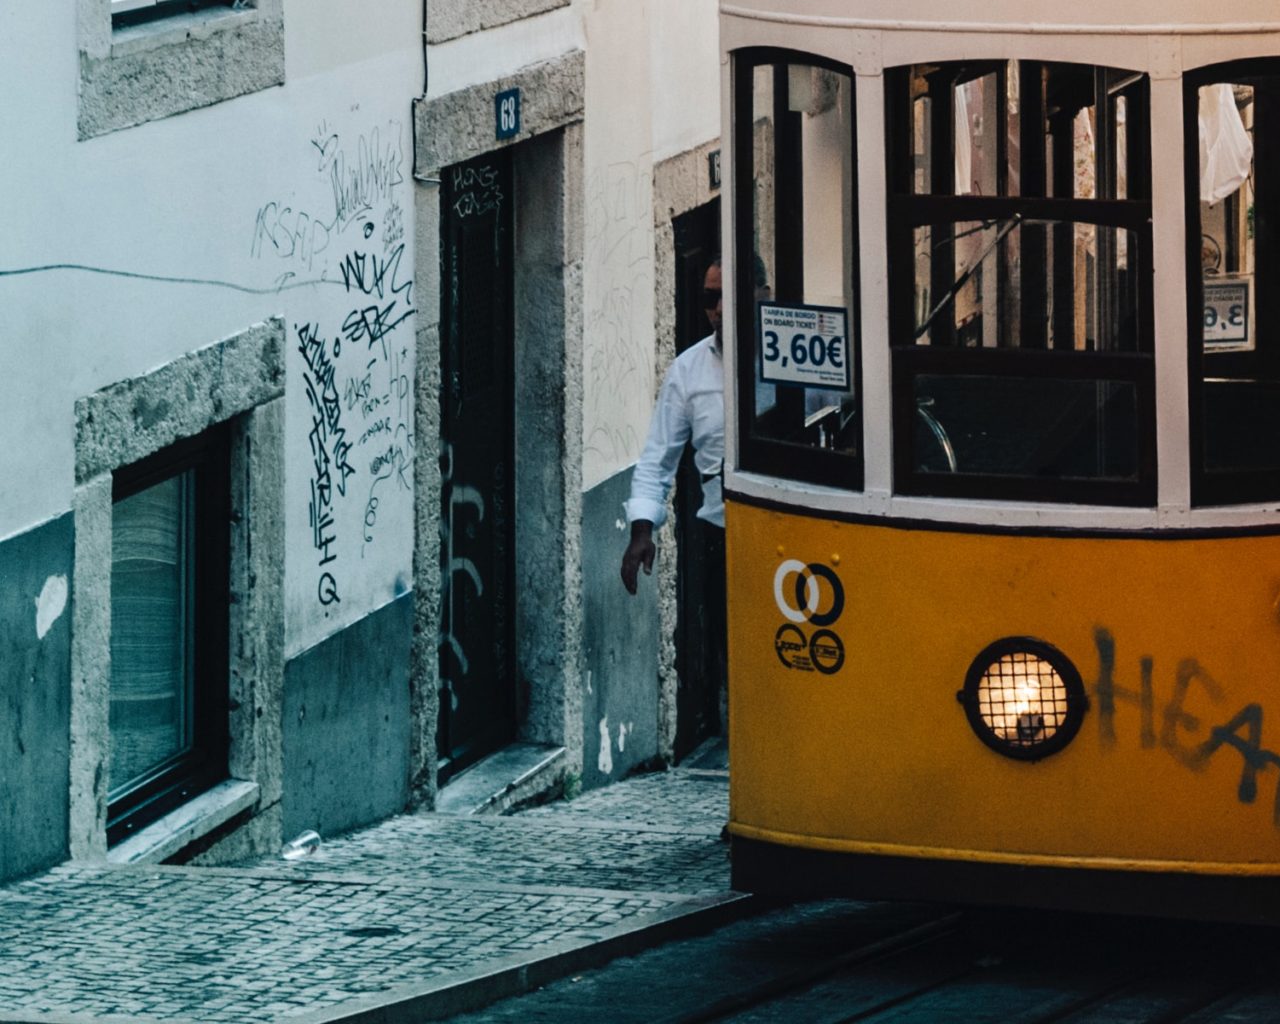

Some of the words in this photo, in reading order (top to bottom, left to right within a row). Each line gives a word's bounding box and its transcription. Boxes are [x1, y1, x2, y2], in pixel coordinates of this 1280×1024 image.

[501, 97, 515, 131] 68
[764, 308, 784, 316] TARIFA
[785, 310, 794, 318] DE
[795, 311, 816, 320] BORDO
[774, 319, 795, 328] BOARD
[796, 320, 816, 329] TICKET
[764, 330, 843, 368] 3,60€
